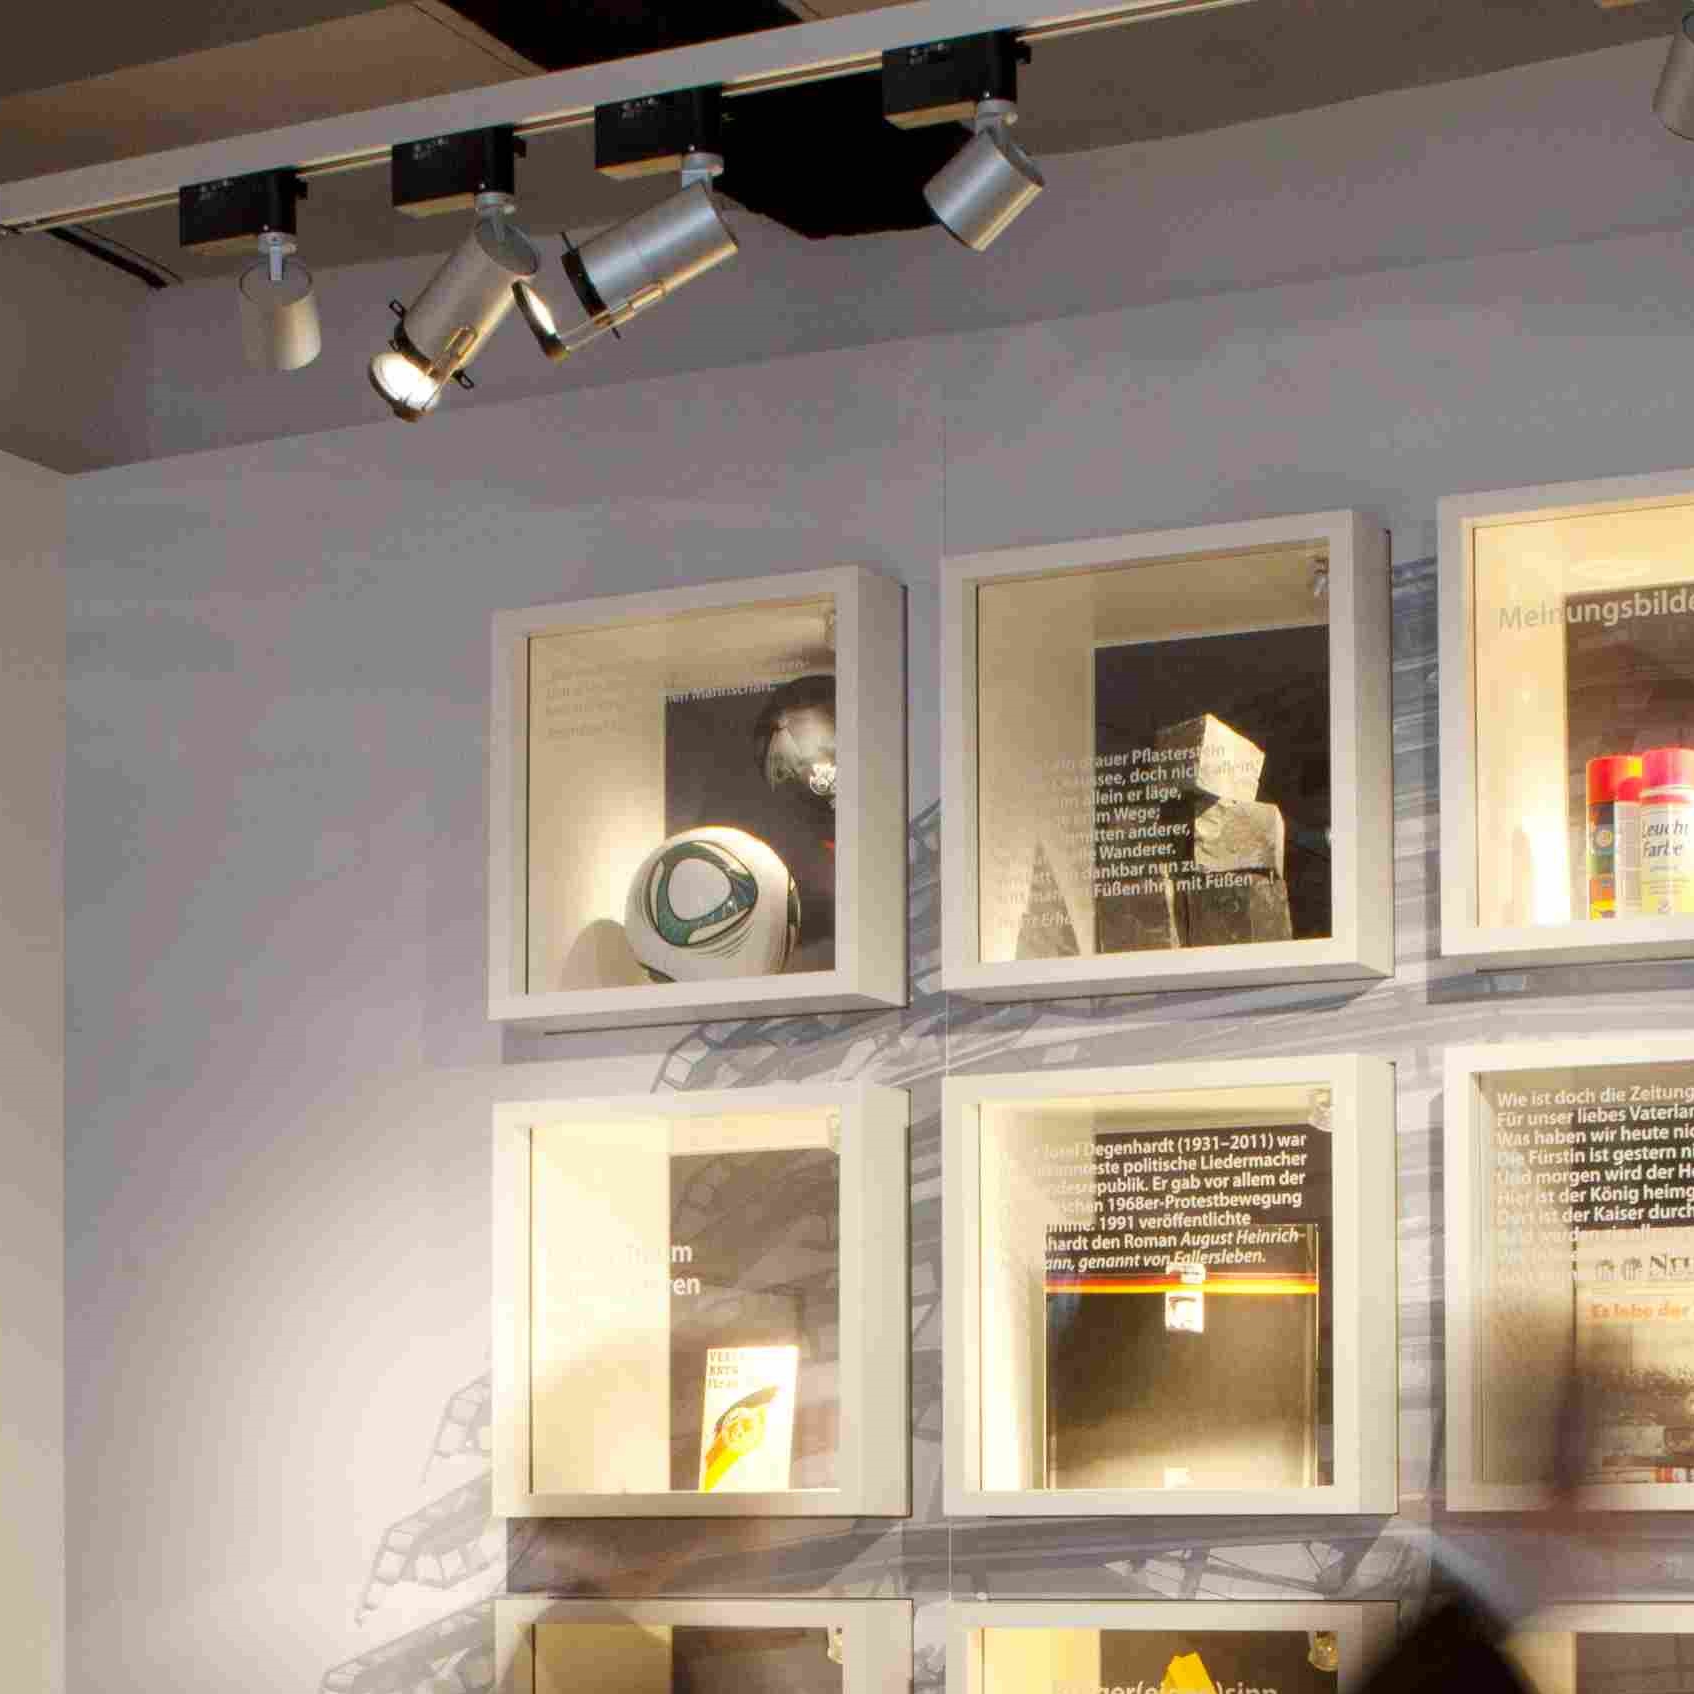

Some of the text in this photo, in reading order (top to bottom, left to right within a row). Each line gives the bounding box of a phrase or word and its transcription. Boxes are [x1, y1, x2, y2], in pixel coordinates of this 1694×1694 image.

[1130, 766, 1167, 783] doch
[1127, 791, 1142, 802] er
[1146, 783, 1182, 804] läge,
[1114, 805, 1161, 826] Wege;
[1128, 822, 1191, 841] anderer,
[1099, 842, 1177, 860] Wanderer.
[1094, 881, 1140, 898] Füßen
[1177, 876, 1203, 892] mit
[1206, 871, 1252, 889] Füßen
[1497, 1091, 1529, 1107] Wie
[1532, 1089, 1552, 1105] ist
[1554, 1087, 1596, 1105] doch
[1600, 1085, 1627, 1103] die
[1496, 1111, 1524, 1128] Für
[1528, 1112, 1574, 1127] unser
[1577, 1106, 1626, 1124] liebes
[1496, 1131, 1530, 1147] Was
[1534, 1128, 1587, 1145] haben
[1590, 1126, 1617, 1142] wir
[1620, 1123, 1670, 1142] heute
[1085, 1138, 1175, 1161] Degenhardt
[1277, 1134, 1307, 1148] war
[1528, 1148, 1587, 1165] Fürstin
[1589, 1146, 1609, 1163] ist
[1612, 1145, 1677, 1166] gestern
[1123, 1151, 1307, 1176] politische Liedermacher
[1152, 1171, 1307, 1194] Er gab vor allem der
[1536, 1168, 1601, 1187] morgen
[1604, 1165, 1643, 1182] wird
[1645, 1164, 1675, 1181] der
[1108, 1191, 1303, 1213] 1968er-Protestbewegung
[1537, 1189, 1555, 1204] ist
[1558, 1187, 1588, 1204] der
[1590, 1185, 1640, 1205] König
[1099, 1212, 1252, 1231] 1991 veröffentlichte
[1561, 1207, 1590, 1223] der
[1593, 1205, 1645, 1222] Kaiser
[1091, 1234, 1121, 1250] den
[1124, 1233, 1177, 1249] Roman
[1179, 1231, 1233, 1250] August
[1078, 1248, 1267, 1273] genannt von Fallersleben.
